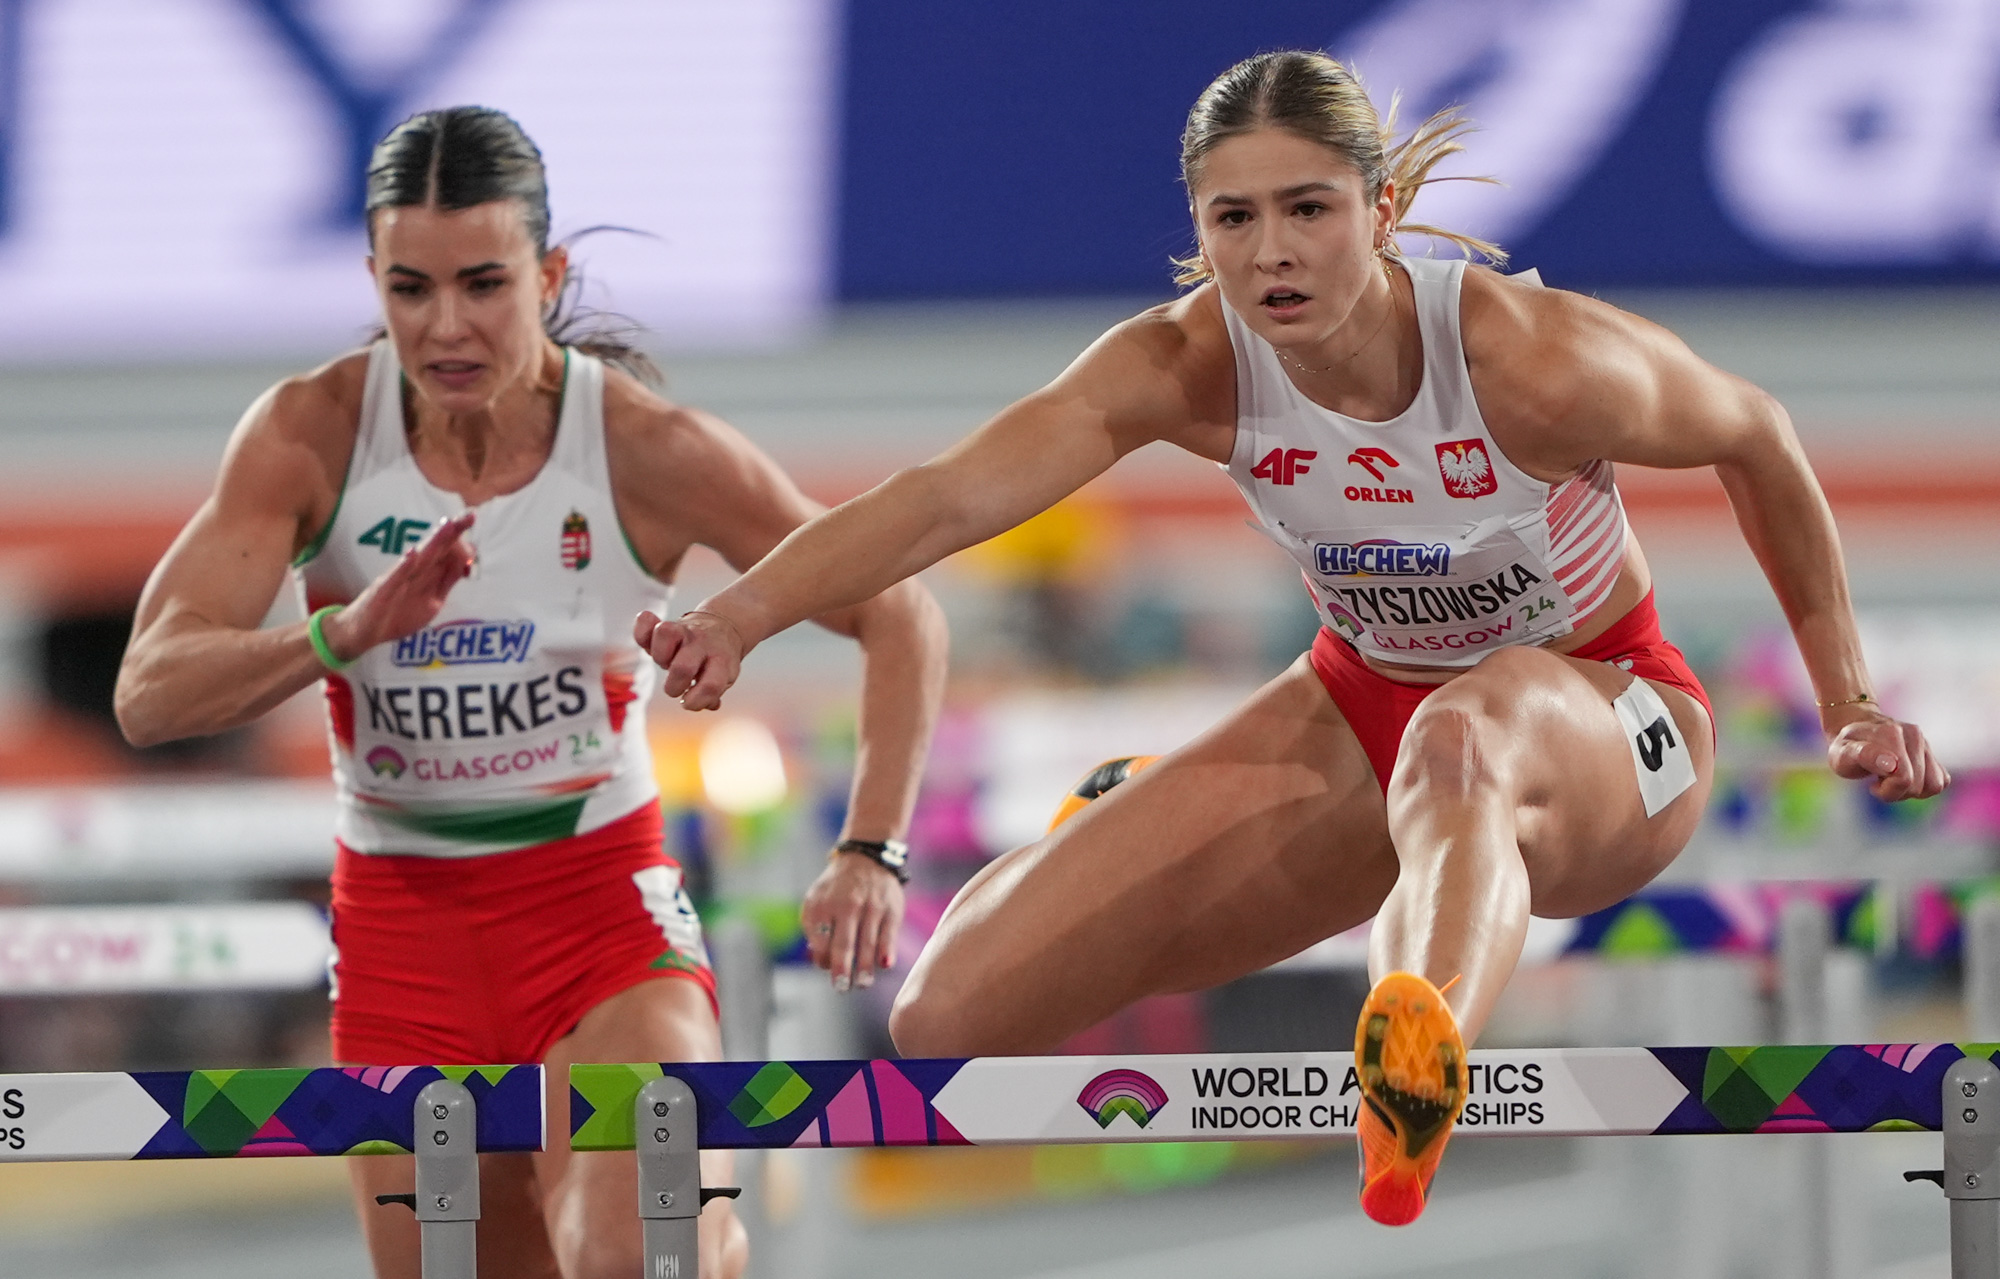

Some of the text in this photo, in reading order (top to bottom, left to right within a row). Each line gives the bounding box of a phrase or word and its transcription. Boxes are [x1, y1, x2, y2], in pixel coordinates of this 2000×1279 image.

[1250, 447, 1318, 486] 4F
[1344, 486, 1414, 503] ORLEN
[358, 516, 431, 554] 4F
[1315, 543, 1450, 576] HI-CHEW
[1372, 595, 1556, 651] GLASGOW 24
[391, 620, 535, 667] HI-CHEW
[362, 666, 587, 740] KEREKES
[413, 730, 602, 781] GLASGOW 24
[1636, 715, 1677, 773] 5
[1191, 1063, 1544, 1098] WORLD ATICS
[1192, 1105, 1301, 1129] INDOOR
